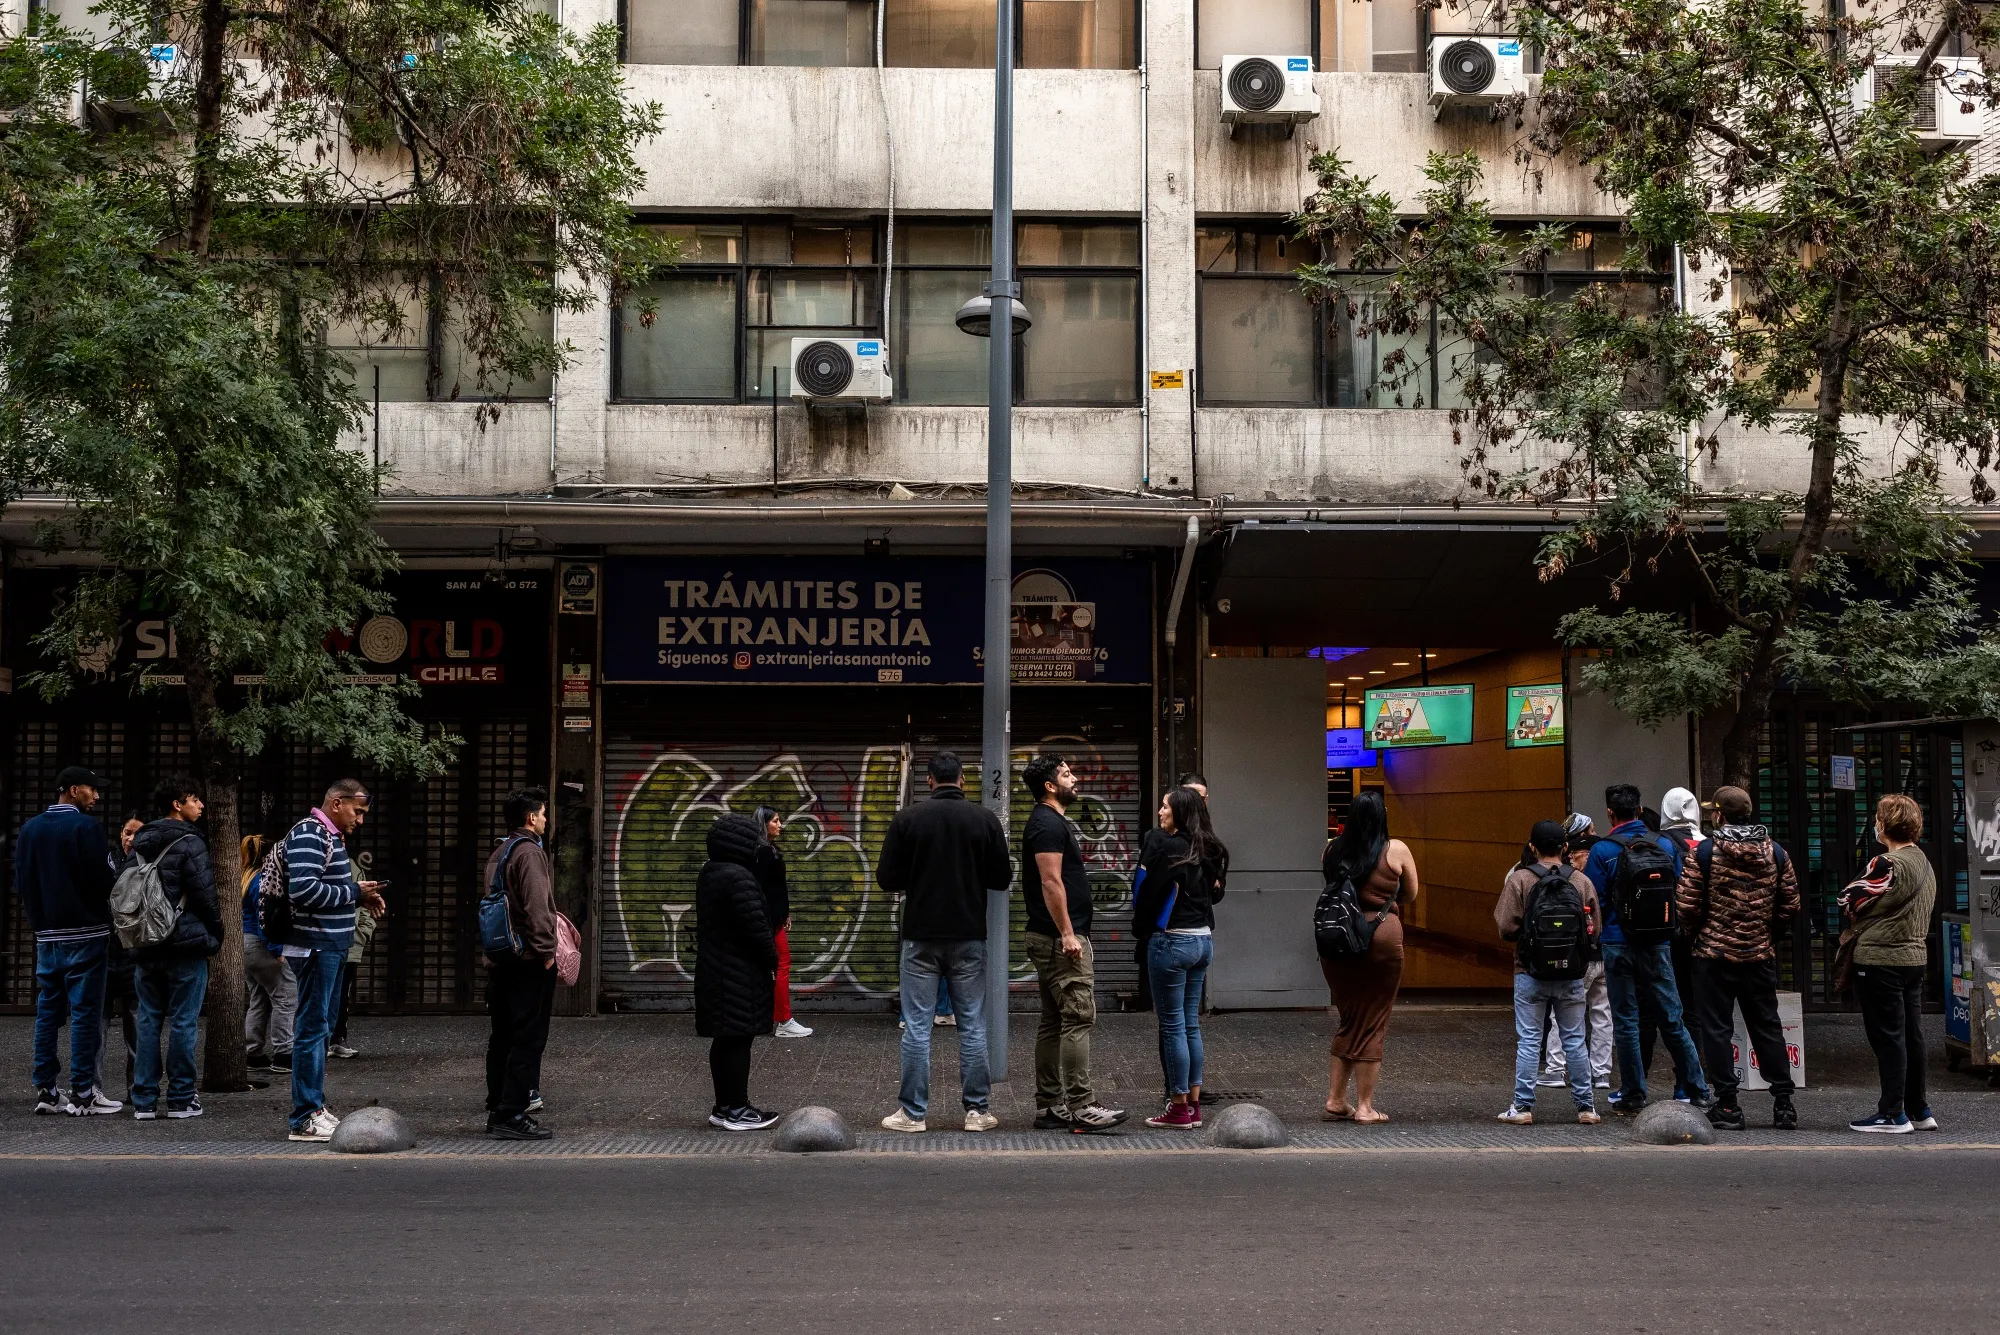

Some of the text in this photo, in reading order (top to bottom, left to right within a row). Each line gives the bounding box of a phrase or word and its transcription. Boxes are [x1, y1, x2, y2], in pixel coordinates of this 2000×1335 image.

[446, 581, 467, 589] SAN
[519, 581, 538, 589] 572
[568, 575, 590, 586] ADT
[664, 571, 922, 610] TRÁMITES DE
[1022, 593, 1058, 603] TRÁMITES
[658, 609, 931, 647] EXTRANJERÍA
[657, 649, 931, 669] Síguenos extranjeriasanantonio
[1093, 647, 1109, 661] 76
[420, 667, 497, 682] CHILE
[880, 671, 900, 681] 576
